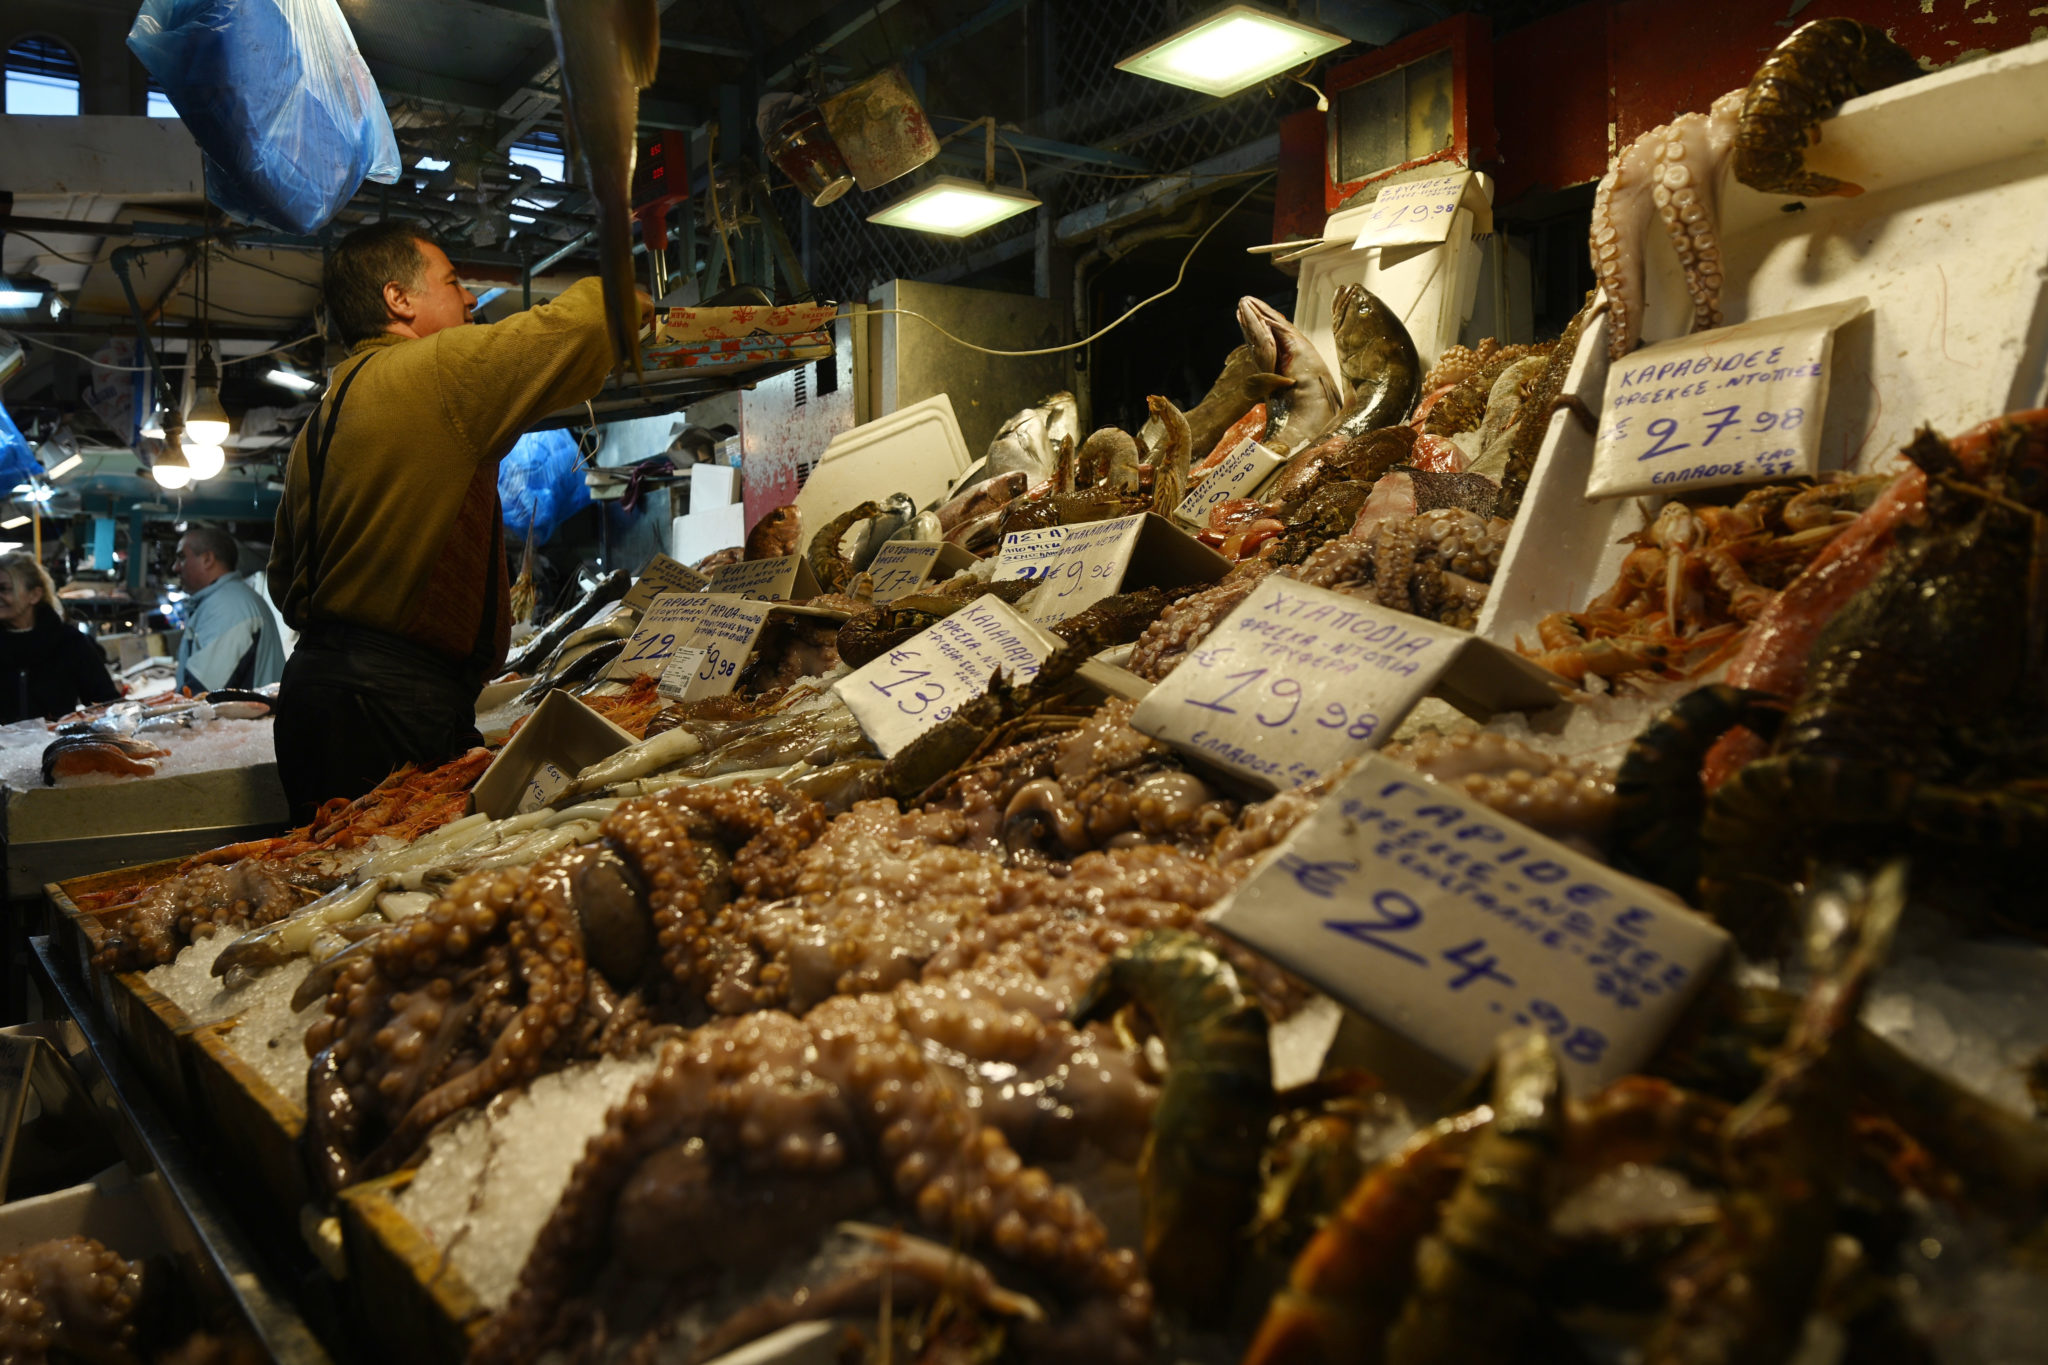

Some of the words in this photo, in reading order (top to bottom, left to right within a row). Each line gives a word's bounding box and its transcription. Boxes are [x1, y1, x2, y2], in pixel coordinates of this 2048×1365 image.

[1620, 346, 1785, 388] ΚΑΡΑΒΙΔΕΣ
[1264, 593, 1433, 656] ΧΤΑΠΟΔΙΑ
[1380, 781, 1657, 938] ΓΑΡΙΔΕΣ
